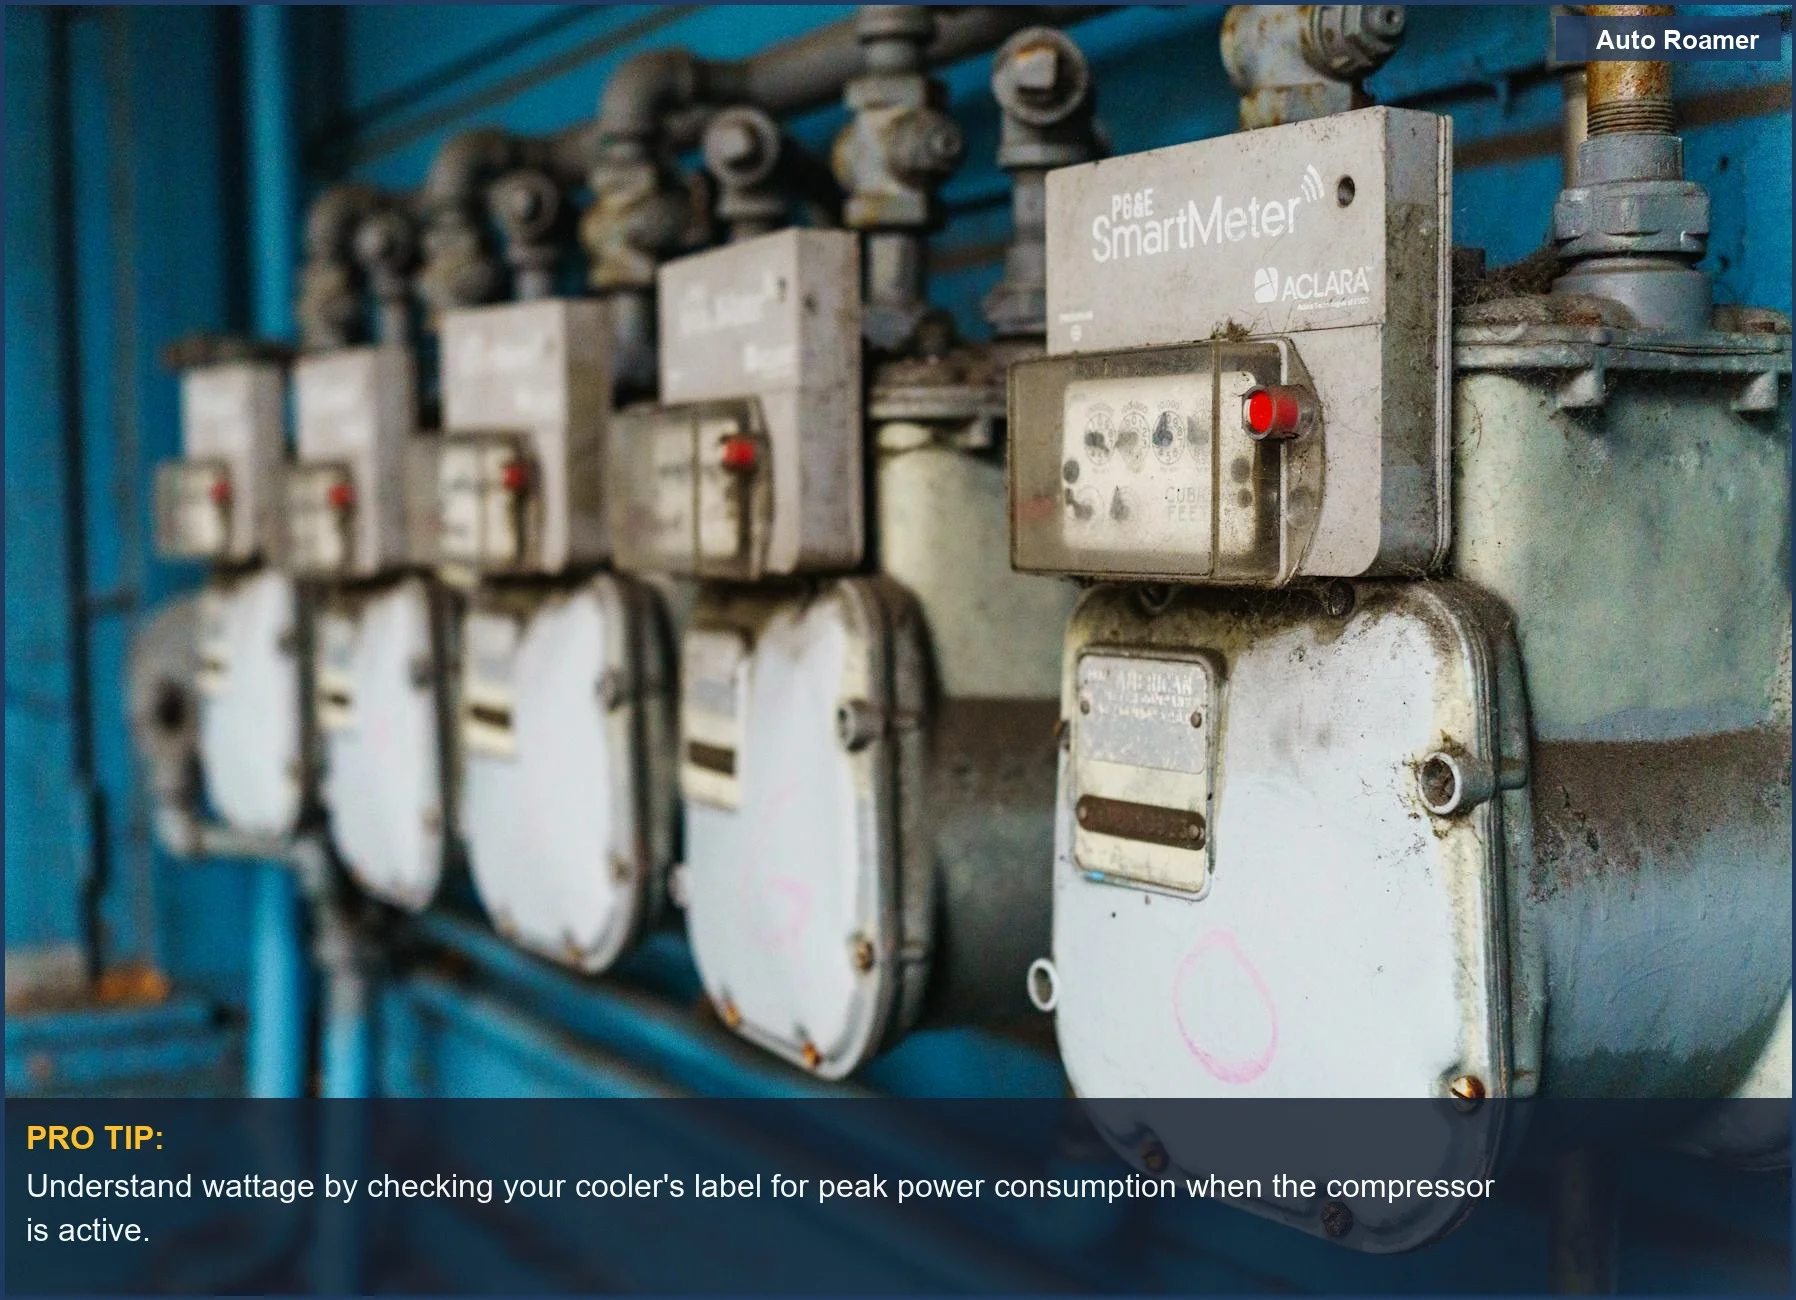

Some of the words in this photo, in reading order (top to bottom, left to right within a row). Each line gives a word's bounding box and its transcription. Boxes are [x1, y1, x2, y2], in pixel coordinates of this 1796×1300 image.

[1111, 187, 1154, 222] PG&E
[1092, 195, 1301, 262] SmartMeter
[1281, 266, 1370, 302] ACLARA
